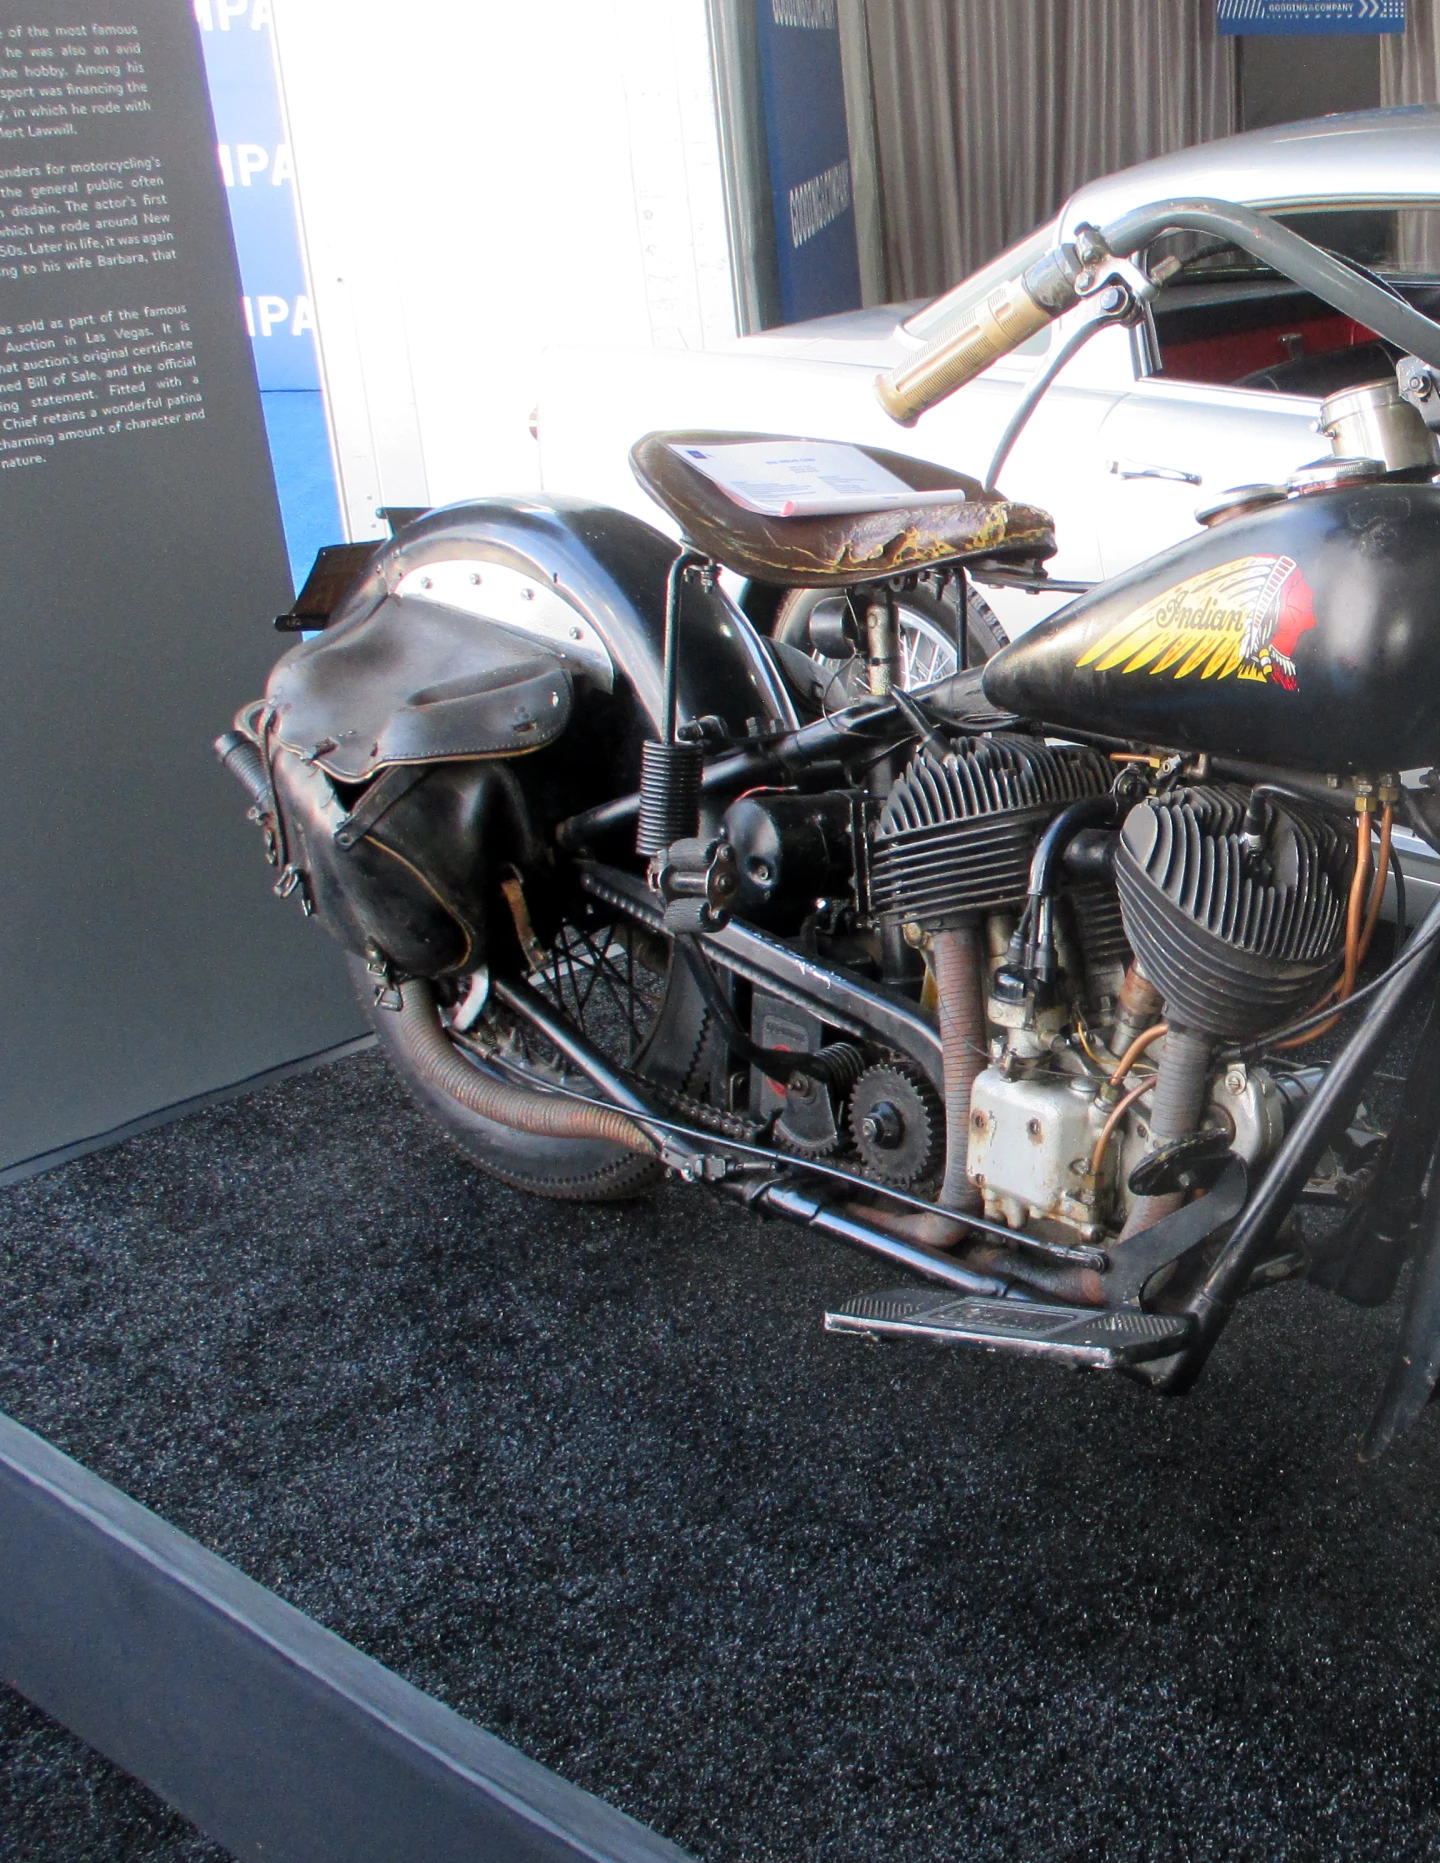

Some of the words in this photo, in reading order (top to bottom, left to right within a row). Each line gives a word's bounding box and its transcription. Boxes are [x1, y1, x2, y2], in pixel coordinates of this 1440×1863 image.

[8, 25, 22, 38] of
[28, 25, 49, 37] the
[55, 25, 87, 36] most
[91, 23, 138, 35] famous
[5, 47, 22, 58] he
[30, 47, 54, 57] was
[61, 45, 86, 56] also
[93, 46, 109, 55] an
[115, 42, 141, 54] avid
[24, 64, 69, 78] hobby.
[75, 62, 121, 77] Among
[127, 61, 145, 73] his
[0, 87, 35, 101] sport
[39, 86, 63, 97] was
[66, 83, 124, 97] financing
[126, 81, 148, 93] the
[13, 107, 26, 118] in
[30, 103, 67, 117] which
[71, 103, 88, 115] he
[91, 102, 121, 114] rode
[124, 100, 152, 112] with
[28, 123, 78, 138] Lawwill.
[46, 163, 65, 175] for
[71, 156, 162, 174] motorcycling's
[0, 187, 22, 198] the
[31, 182, 79, 199] general
[86, 178, 124, 194] public
[131, 176, 164, 188] often
[11, 203, 61, 217] disdain.
[64, 200, 89, 212] The
[94, 196, 137, 210] actor's
[143, 194, 168, 206] first
[39, 222, 55, 234] he
[61, 220, 90, 232] rode
[95, 215, 138, 229] around
[143, 213, 170, 224] New
[29, 242, 66, 255] Later
[65, 240, 77, 251] in
[79, 238, 104, 250] life,
[106, 236, 115, 247] it
[117, 234, 140, 246] was
[142, 231, 174, 246] again
[23, 264, 38, 275] to
[42, 260, 61, 273] his
[65, 256, 92, 270] wife
[97, 252, 149, 267] Barbara,
[152, 249, 177, 261] that
[18, 319, 45, 334] sold
[50, 320, 64, 330] as
[68, 314, 95, 329] part
[100, 310, 114, 323] of
[118, 309, 139, 321] the
[144, 304, 187, 318] famous
[5, 338, 56, 354] Auction
[64, 335, 76, 346] in
[85, 332, 106, 344] Las
[113, 327, 154, 341] Vegas.
[162, 322, 172, 334] It
[180, 321, 190, 332] is
[23, 354, 80, 371] auction's
[83, 347, 129, 363] original
[132, 340, 193, 357] certificate
[27, 376, 48, 389] Bill
[53, 373, 67, 386] of
[71, 371, 101, 383] Sale,
[105, 367, 128, 378] and
[132, 364, 153, 375] the
[157, 356, 197, 371] official
[31, 390, 99, 408] statement.
[109, 381, 146, 396] Fitted
[156, 376, 182, 389] with
[192, 376, 200, 385] a
[3, 415, 38, 431] Chief
[42, 408, 86, 424] retains
[90, 409, 98, 418] a
[102, 397, 163, 415] wonderful
[166, 393, 202, 409] patina
[58, 425, 105, 441] amount
[108, 421, 122, 433] of
[125, 414, 181, 431] character
[184, 408, 206, 421] and
[1, 454, 47, 469] nature.
[1155, 590, 1243, 632] Indian
